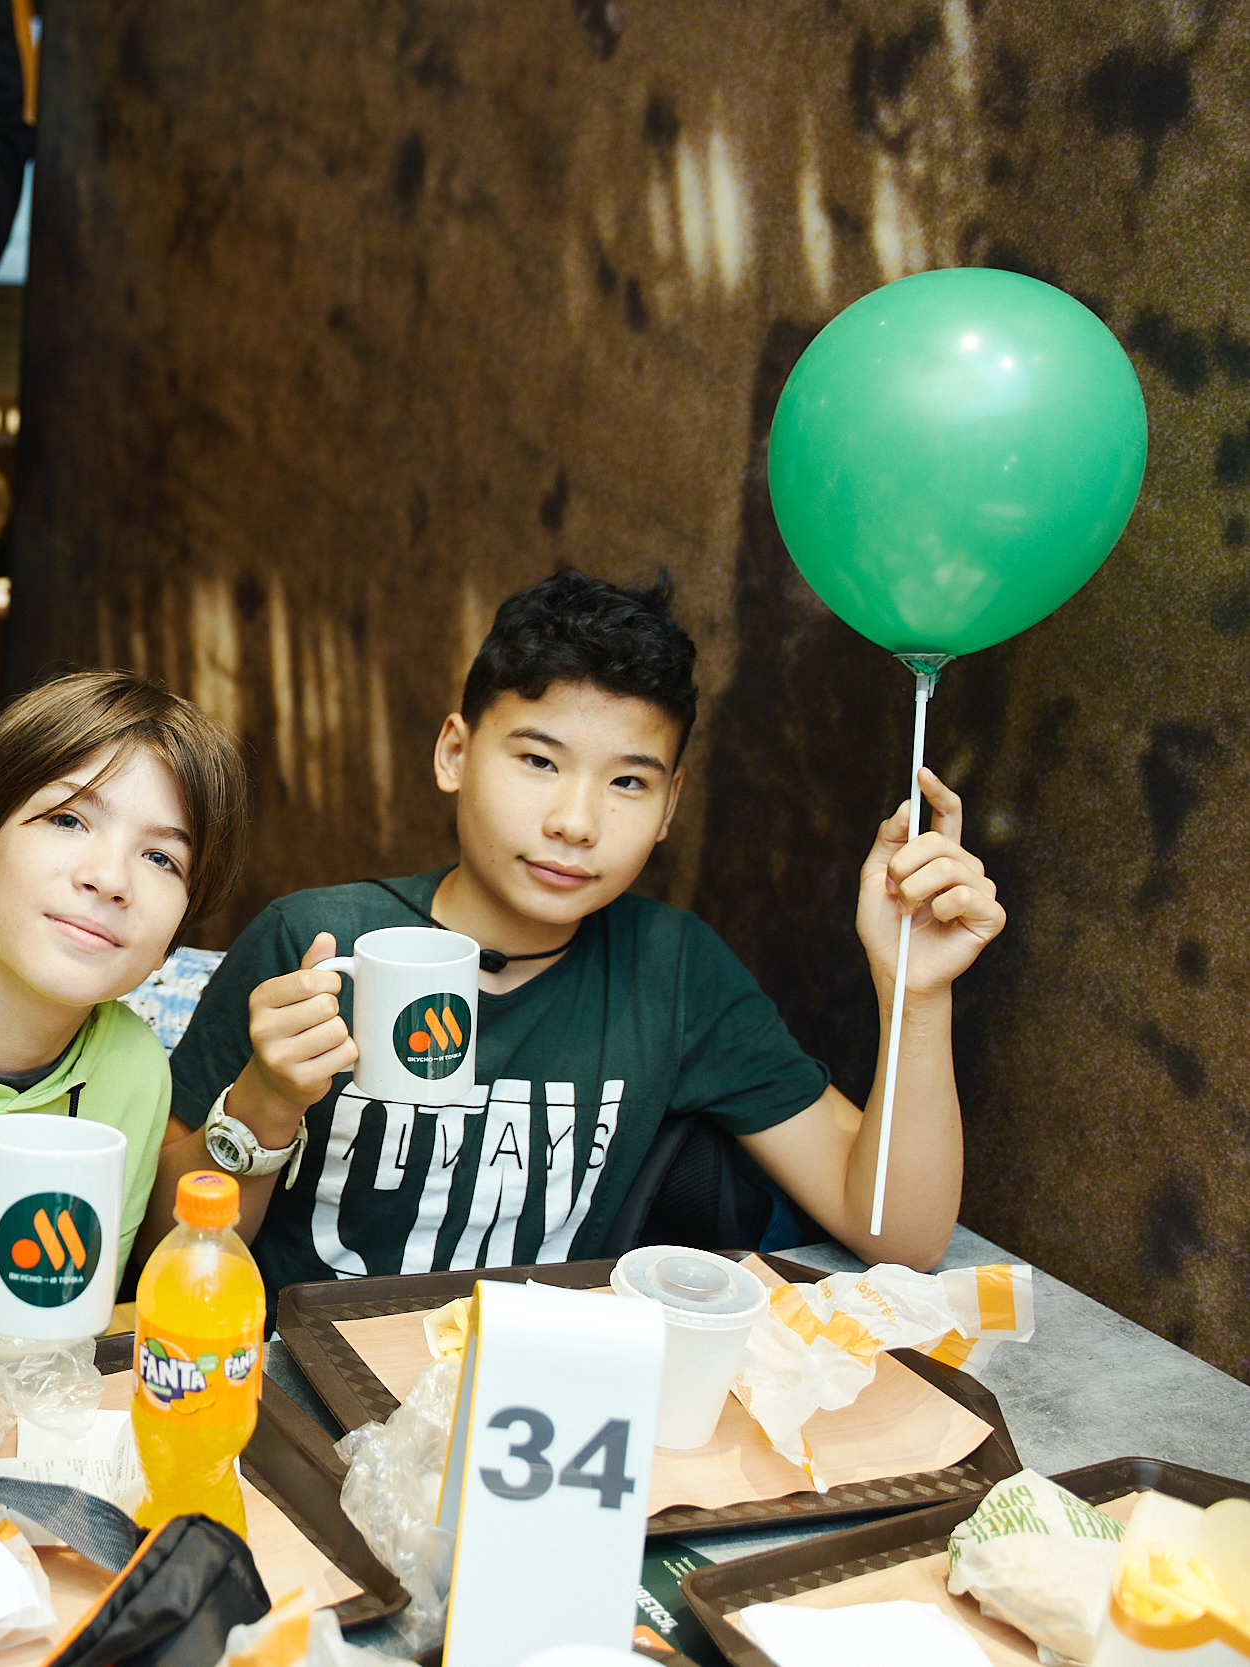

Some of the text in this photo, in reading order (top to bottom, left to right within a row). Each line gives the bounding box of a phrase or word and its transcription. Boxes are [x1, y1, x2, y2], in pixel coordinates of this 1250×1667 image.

[445, 1052, 461, 1060] ТОЧКА
[138, 1343, 207, 1391] FANTA
[223, 1347, 258, 1378] FANT
[478, 1405, 636, 1511] 34
